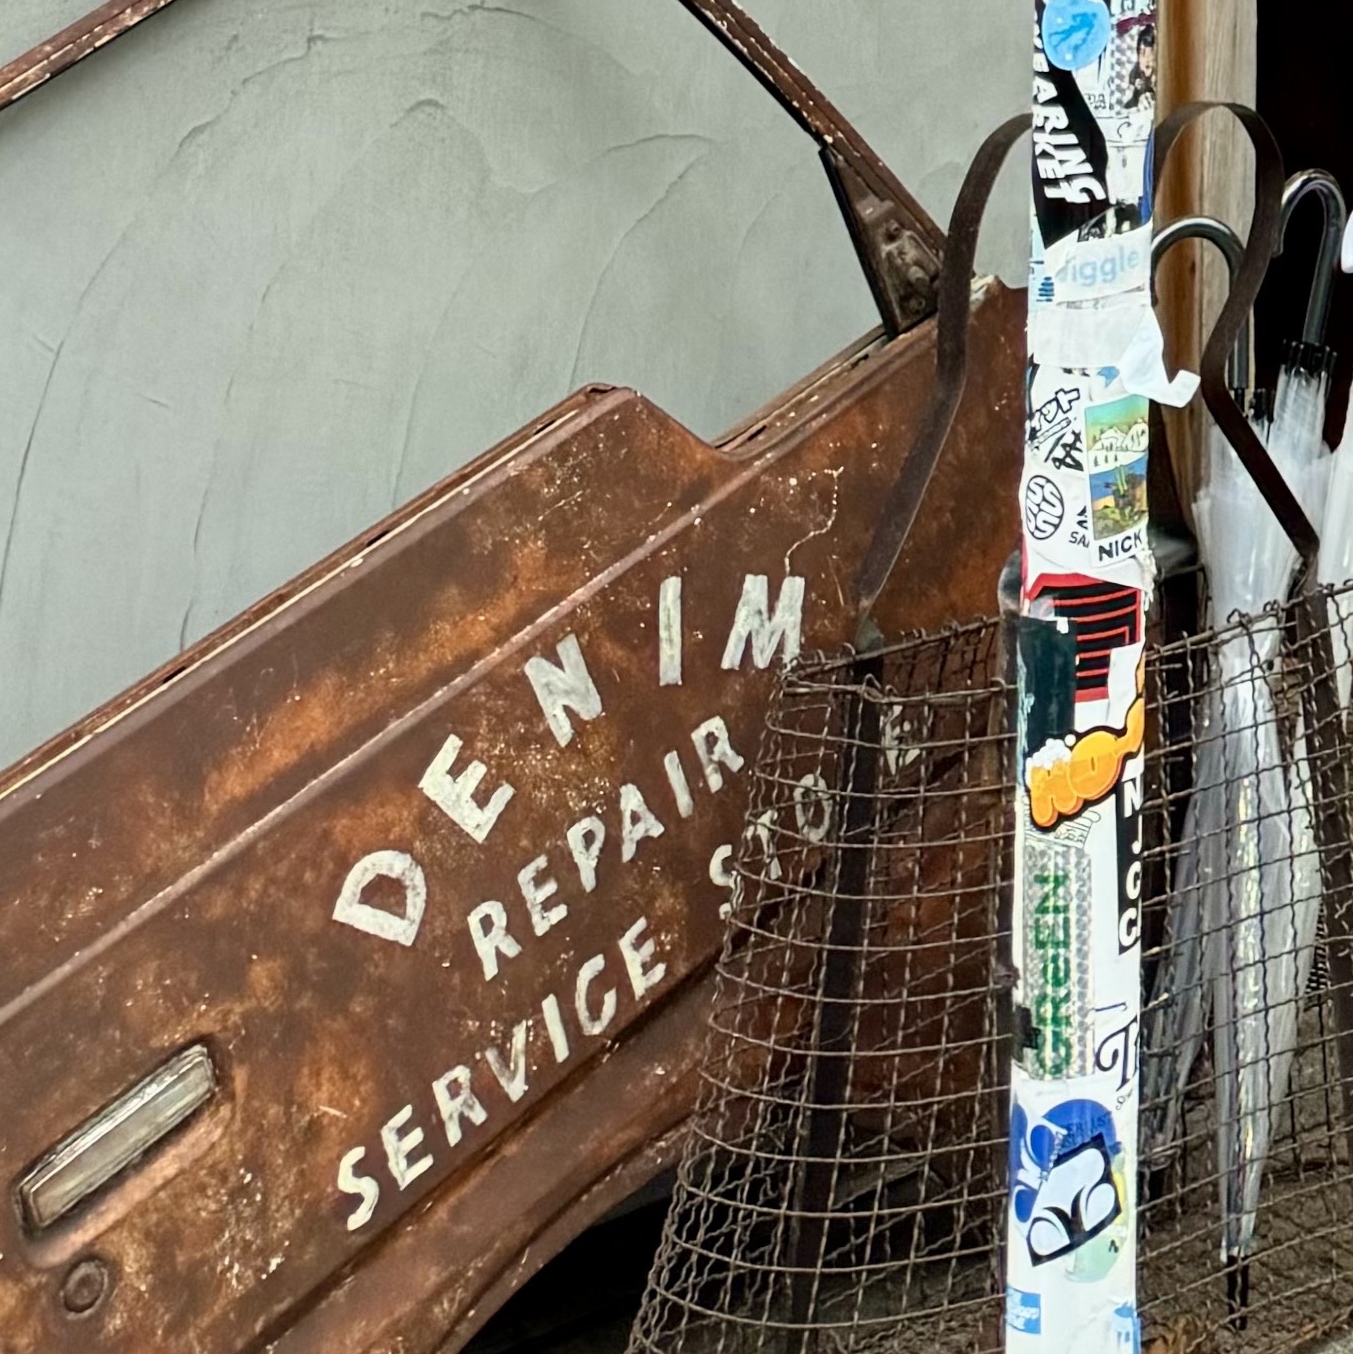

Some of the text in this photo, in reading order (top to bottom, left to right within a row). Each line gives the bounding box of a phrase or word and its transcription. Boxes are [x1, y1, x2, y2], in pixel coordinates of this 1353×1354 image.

[1056, 246, 1139, 287] iggle
[1098, 528, 1143, 562] NICK
[333, 573, 806, 947] DENIM
[467, 715, 745, 982] REPAIR
[337, 917, 667, 1231] SERVICE
